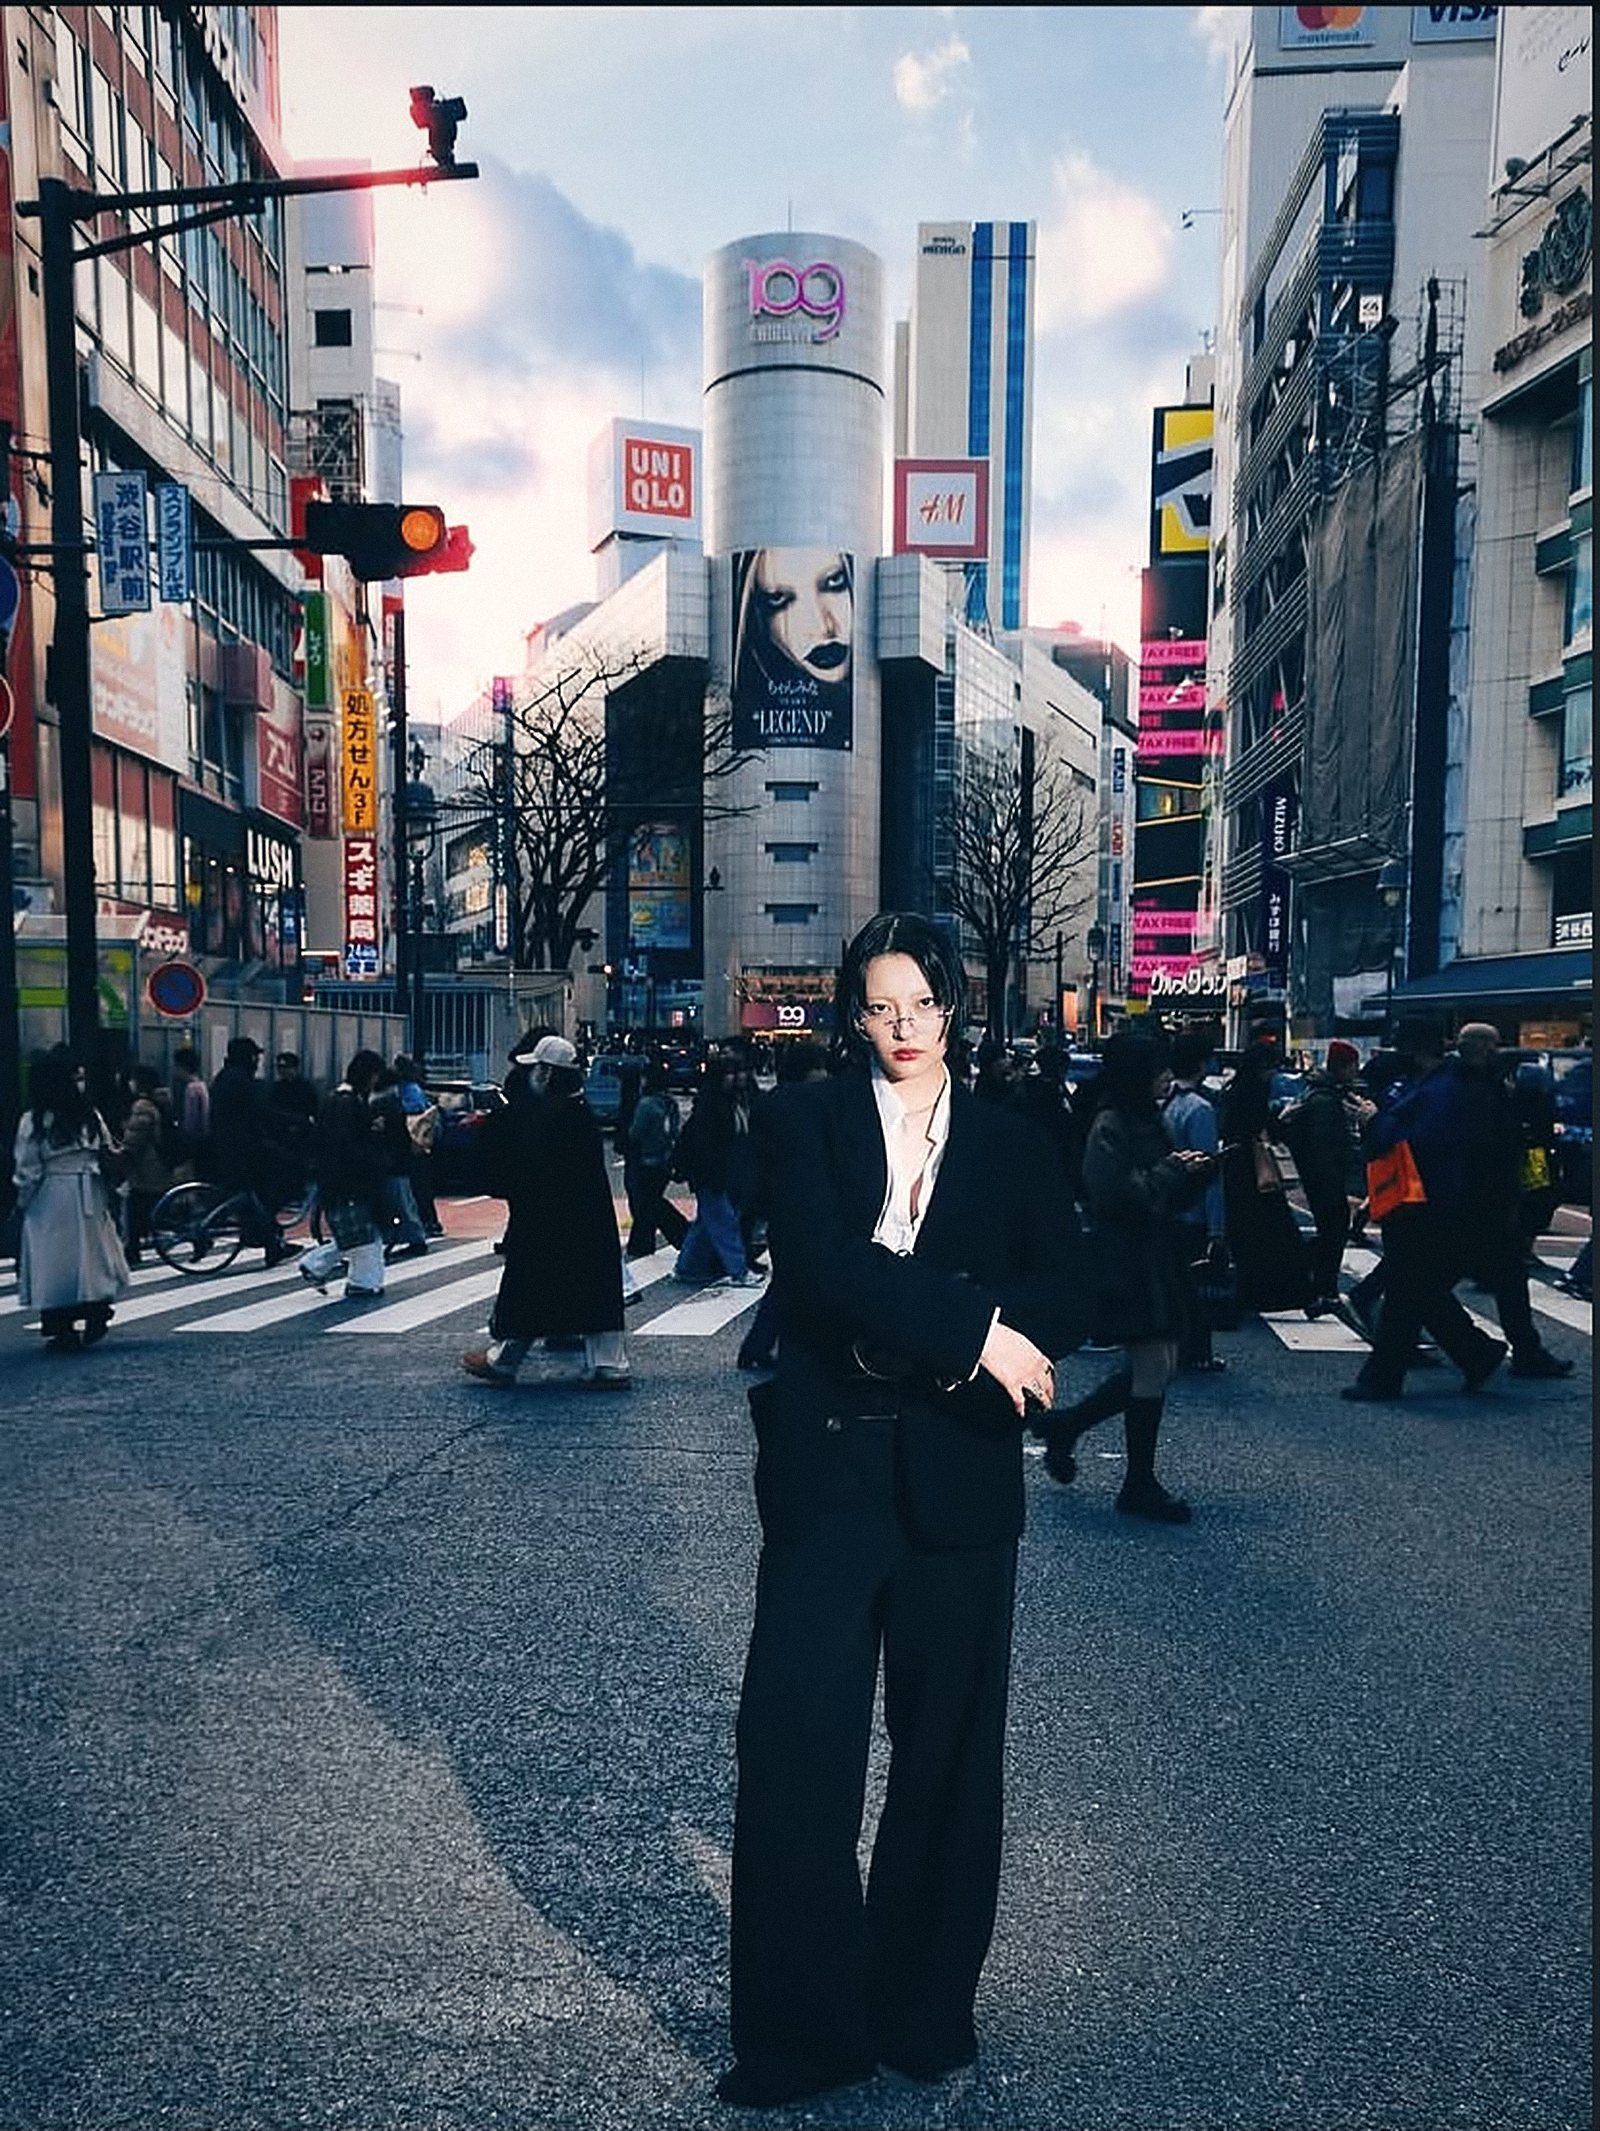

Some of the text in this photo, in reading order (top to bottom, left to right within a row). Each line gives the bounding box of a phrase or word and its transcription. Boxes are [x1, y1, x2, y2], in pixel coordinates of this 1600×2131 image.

[744, 260, 843, 340] 109
[631, 447, 681, 480] UNI
[631, 481, 686, 509] QLO
[116, 482, 145, 601] 渋谷駅前
[1165, 736, 1197, 749] FREE
[247, 830, 293, 889] LUSH
[347, 840, 375, 941] スギ薬局
[1135, 916, 1193, 929] TAX FREE
[777, 1006, 805, 1026] 109
